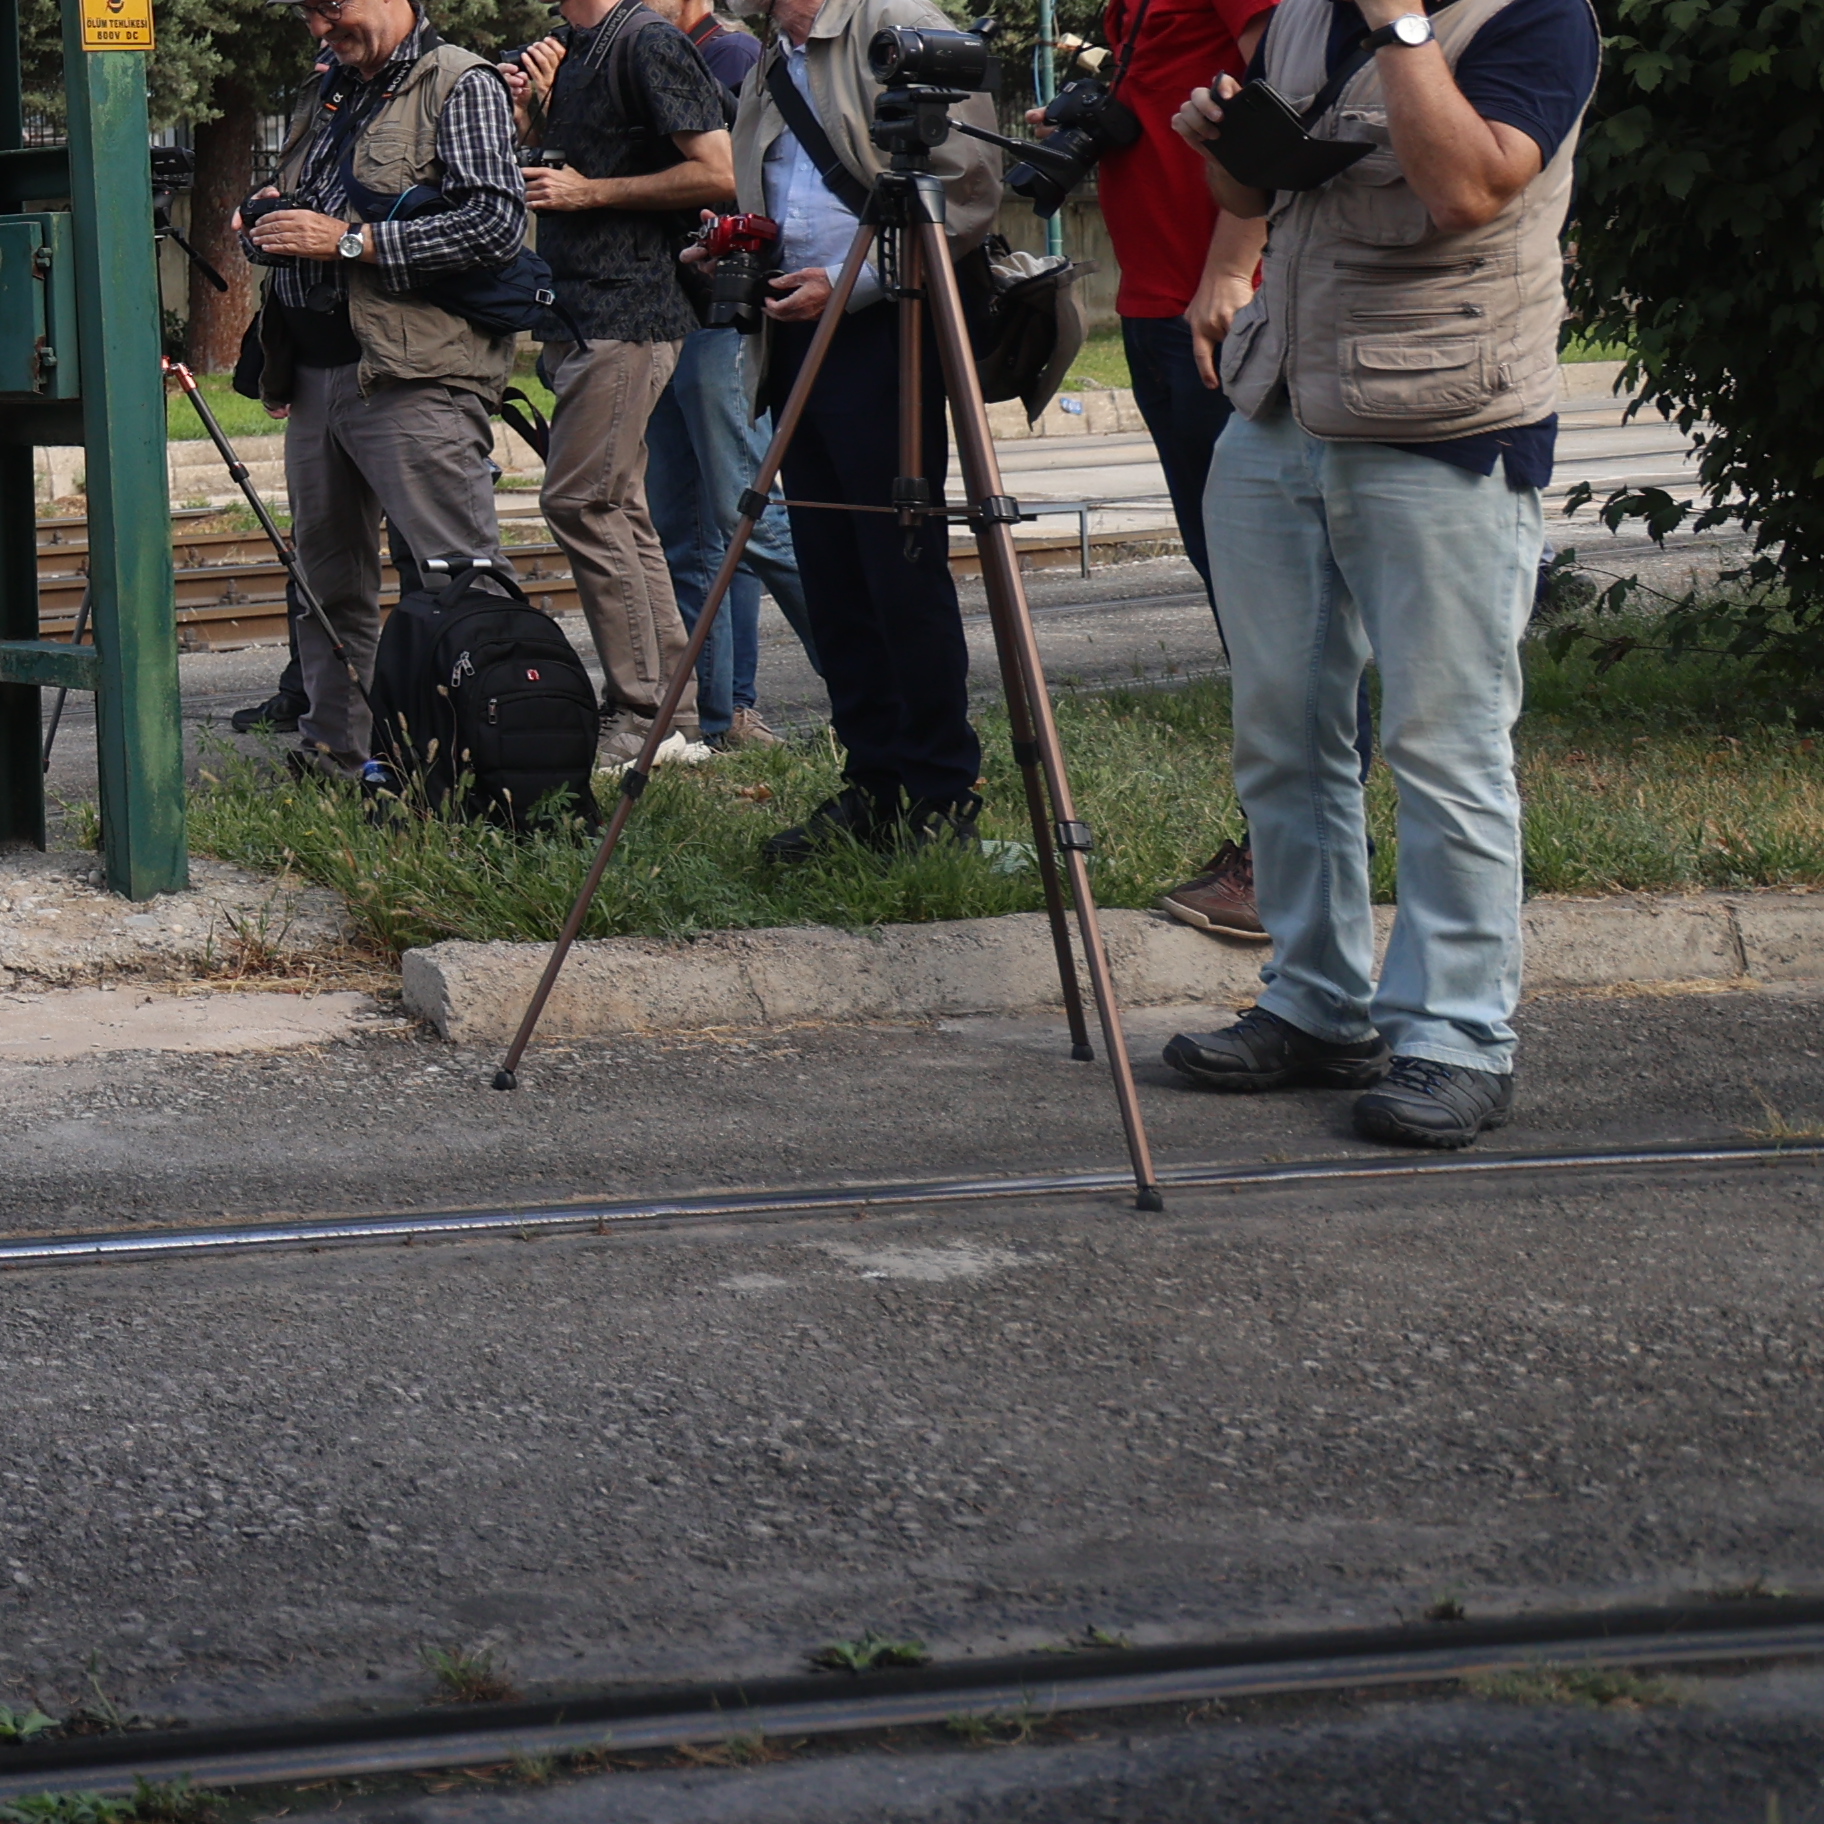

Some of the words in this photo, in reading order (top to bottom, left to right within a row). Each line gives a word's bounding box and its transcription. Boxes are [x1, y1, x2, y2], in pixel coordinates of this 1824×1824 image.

[86, 17, 108, 28] ÖLÜM
[109, 17, 148, 29] TEHLİKESİ
[126, 31, 139, 40] DC
[595, 8, 628, 54] OLYMPUS
